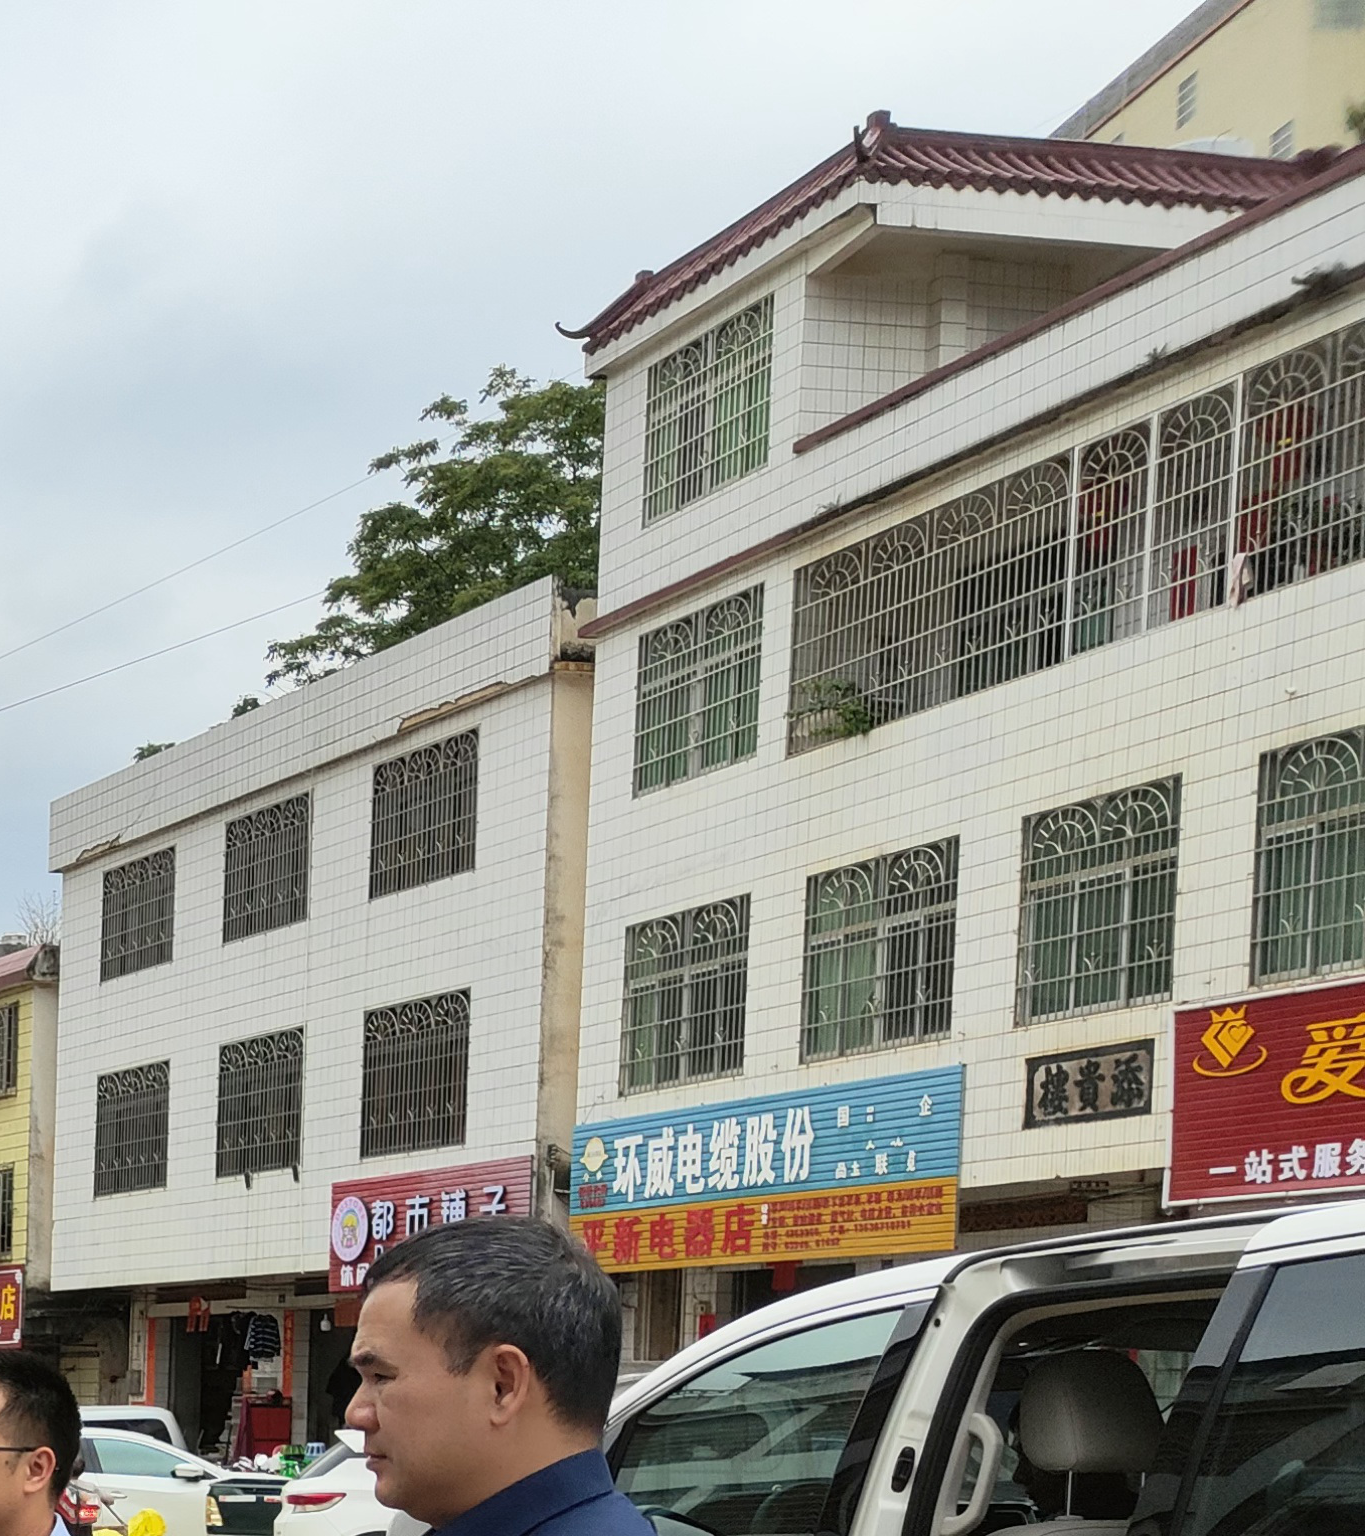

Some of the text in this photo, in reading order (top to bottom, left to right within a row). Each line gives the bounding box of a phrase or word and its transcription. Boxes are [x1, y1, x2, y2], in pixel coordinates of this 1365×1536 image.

[612, 1105, 815, 1202] 环威电缆股份
[1208, 1138, 1365, 1184] 一站式服务
